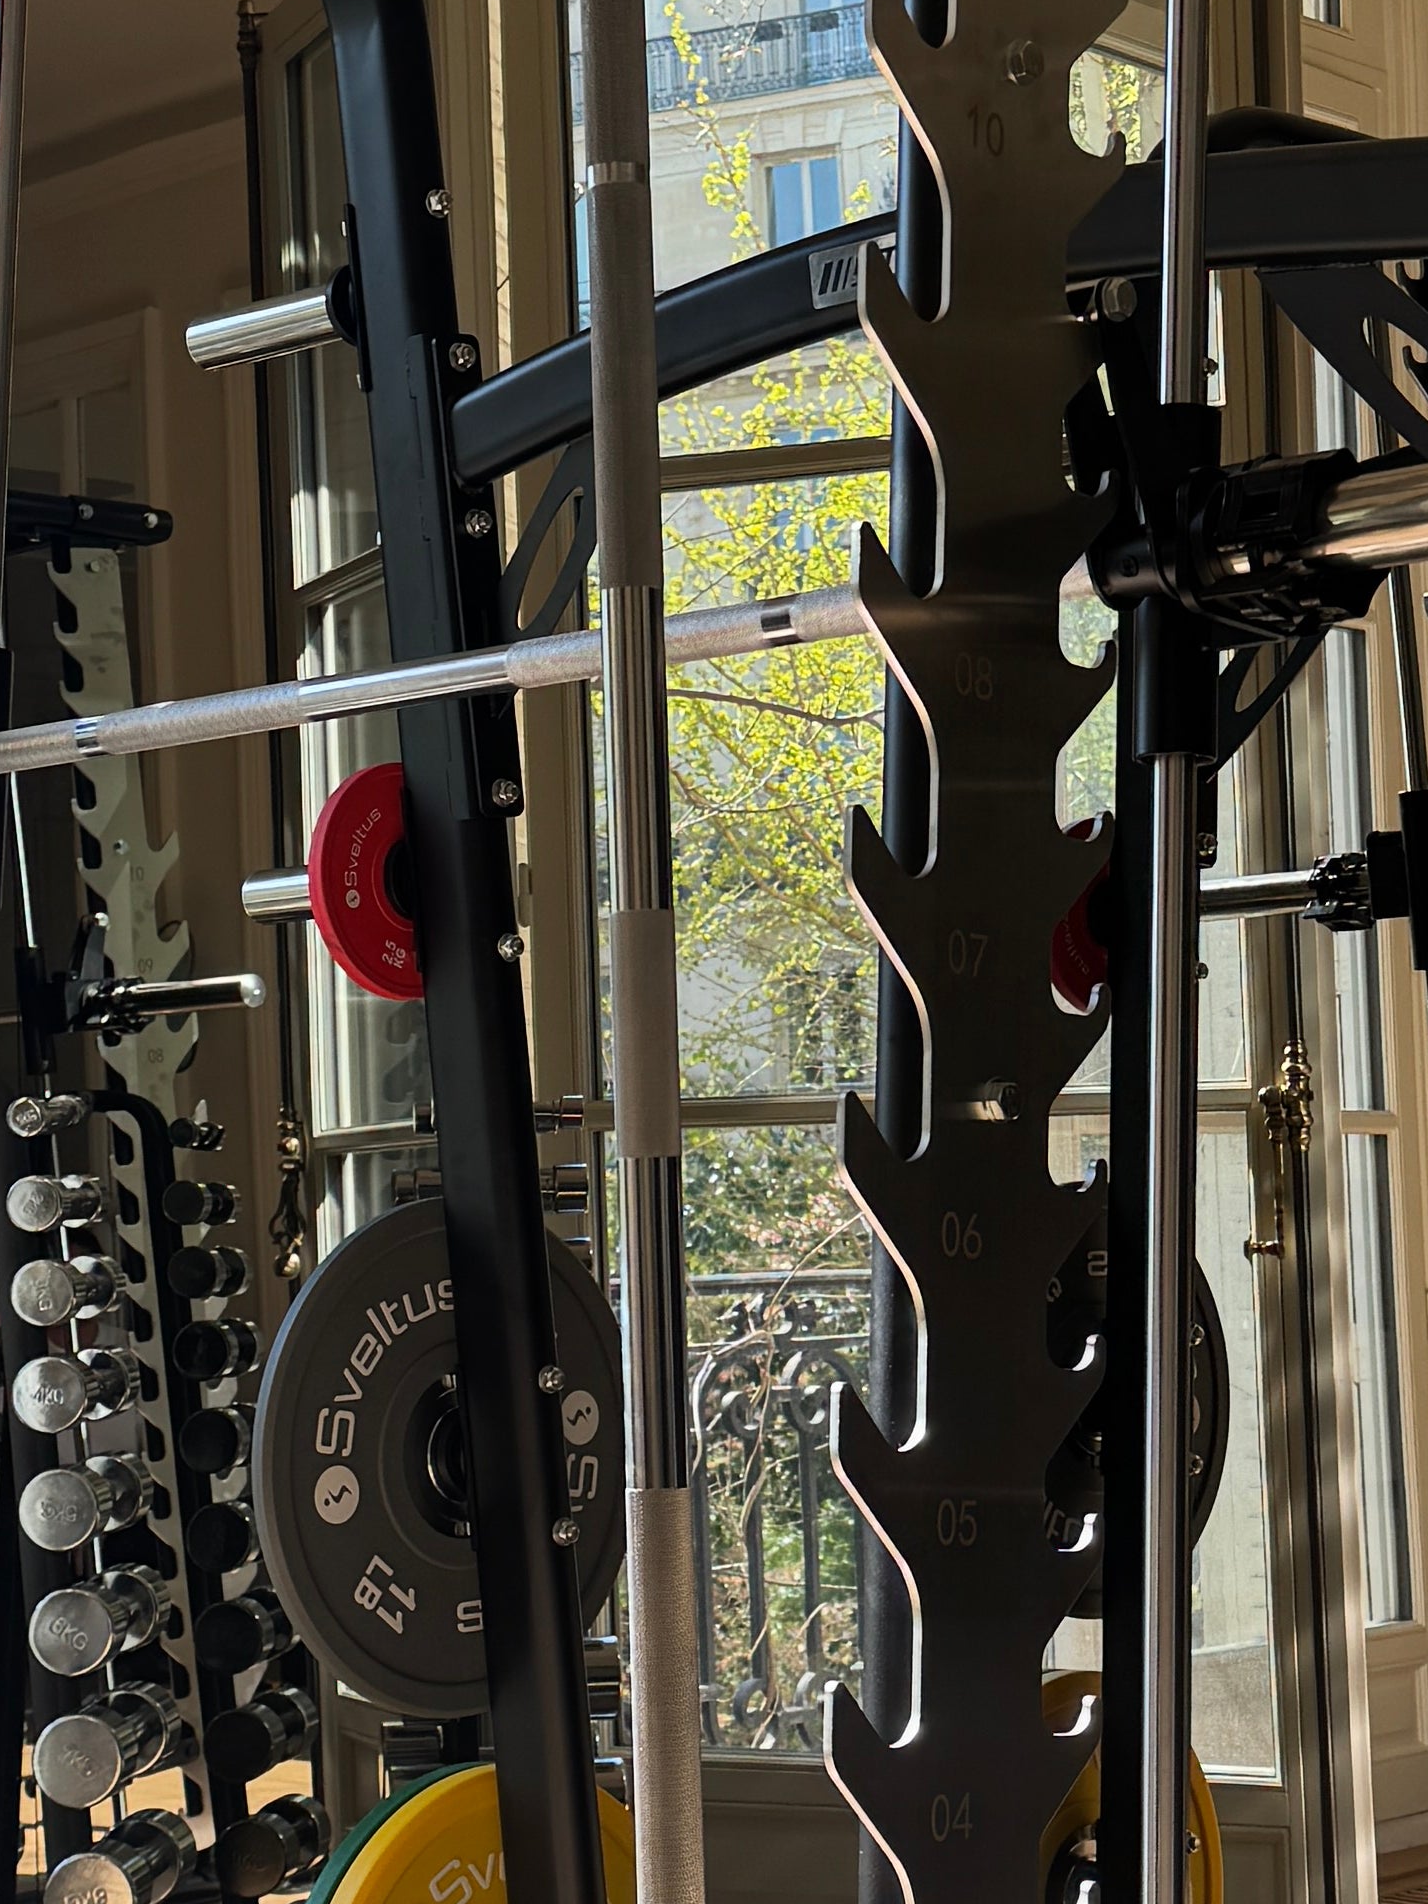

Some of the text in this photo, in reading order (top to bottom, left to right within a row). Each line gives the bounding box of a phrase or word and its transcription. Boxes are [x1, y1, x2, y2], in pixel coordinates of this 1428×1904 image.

[965, 104, 1005, 157] 10
[955, 653, 994, 700] 08
[344, 807, 381, 887] Sveltus
[381, 939, 397, 966] 2.5
[392, 948, 407, 970] KG
[948, 929, 989, 977] 07
[941, 1211, 982, 1259] 06
[936, 1498, 978, 1547] 05
[354, 1555, 394, 1611] LB
[376, 1583, 416, 1634] 11
[931, 1793, 973, 1842] 04
